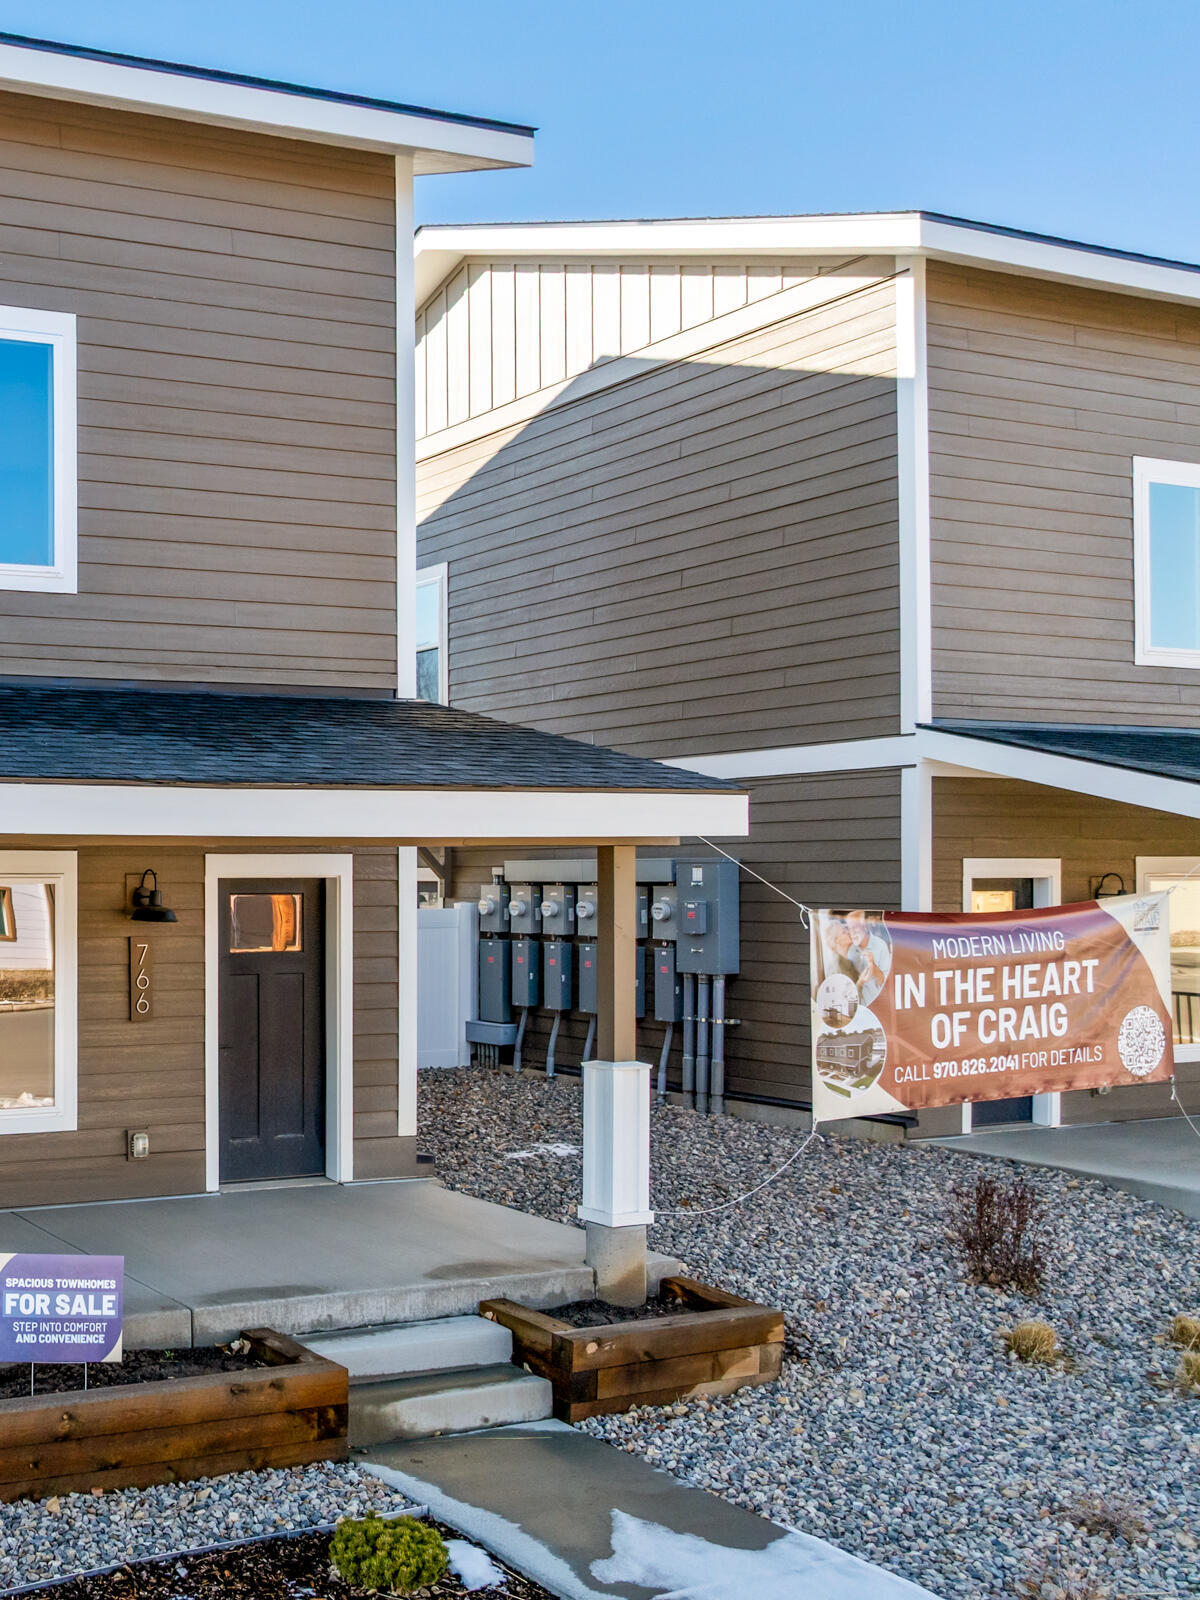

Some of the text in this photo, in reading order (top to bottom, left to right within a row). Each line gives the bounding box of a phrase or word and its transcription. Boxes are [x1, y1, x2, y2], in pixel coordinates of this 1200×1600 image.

[932, 931, 1065, 959] MODERN LIVING
[136, 944, 150, 1014] 766
[894, 958, 1099, 1010] IN THE HEART
[931, 1002, 1068, 1049] OF CRAIG
[894, 1045, 1103, 1083] CALL 970.826.2041 FOR DETAILS
[5, 1278, 116, 1289] SPACIOUS TOWNHOMES
[4, 1293, 116, 1316] FOR SALE
[12, 1321, 108, 1332] STEP INTO COMFORT
[15, 1334, 105, 1344] AND CONVENIENCE
